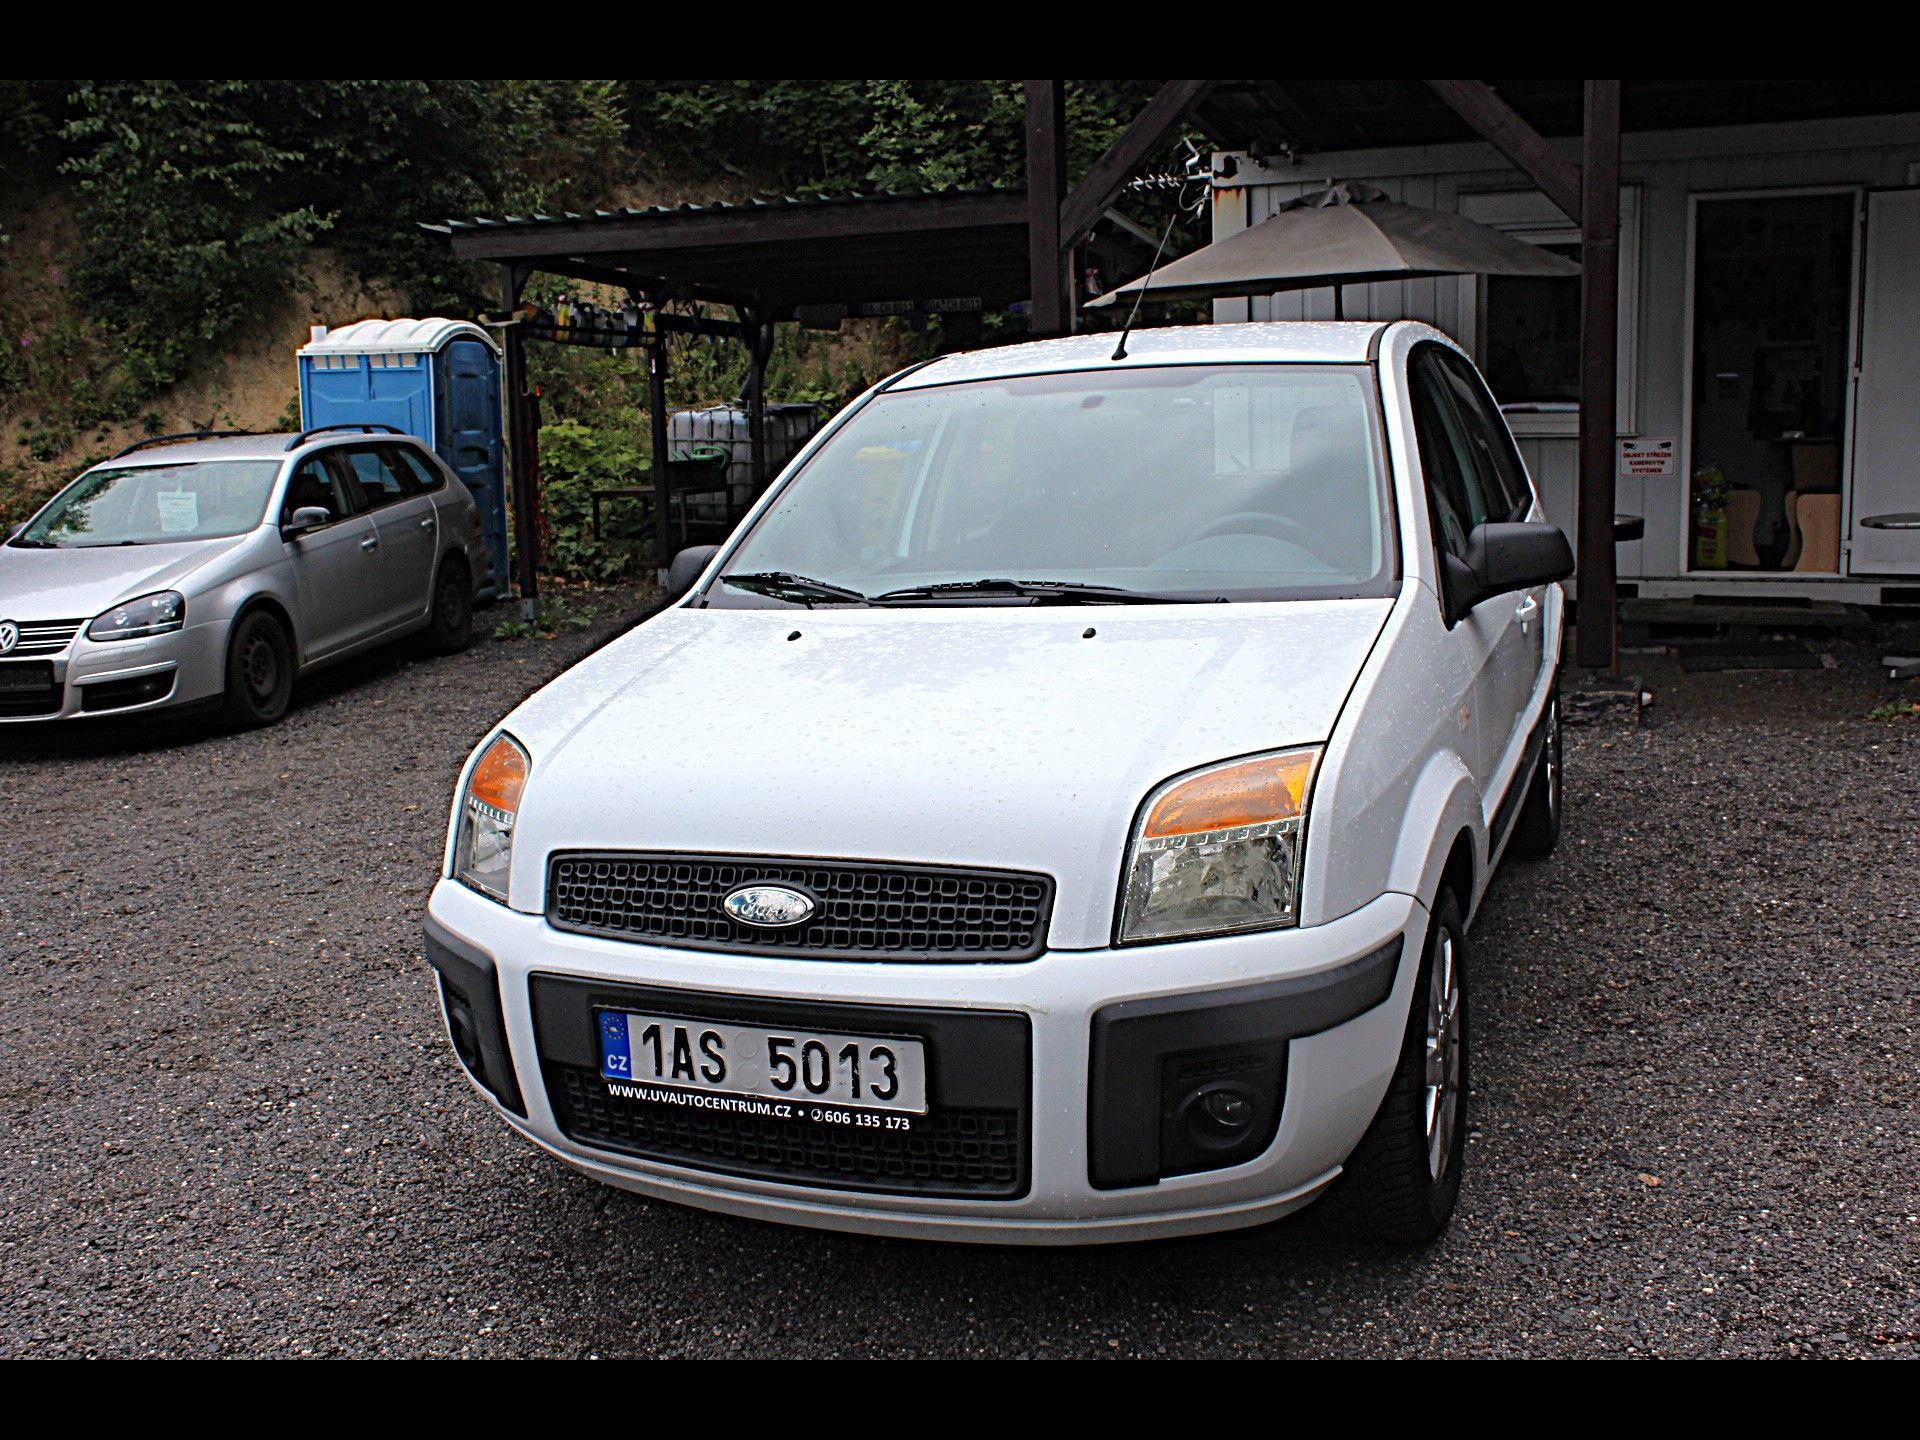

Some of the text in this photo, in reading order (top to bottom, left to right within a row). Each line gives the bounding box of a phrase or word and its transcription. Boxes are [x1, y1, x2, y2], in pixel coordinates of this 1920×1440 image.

[607, 1054, 628, 1072] CZ
[643, 1023, 899, 1101] 1AS 5013
[608, 1083, 910, 1131] WWW.UVAUTOCENTRUM.CZ 606 135 173
